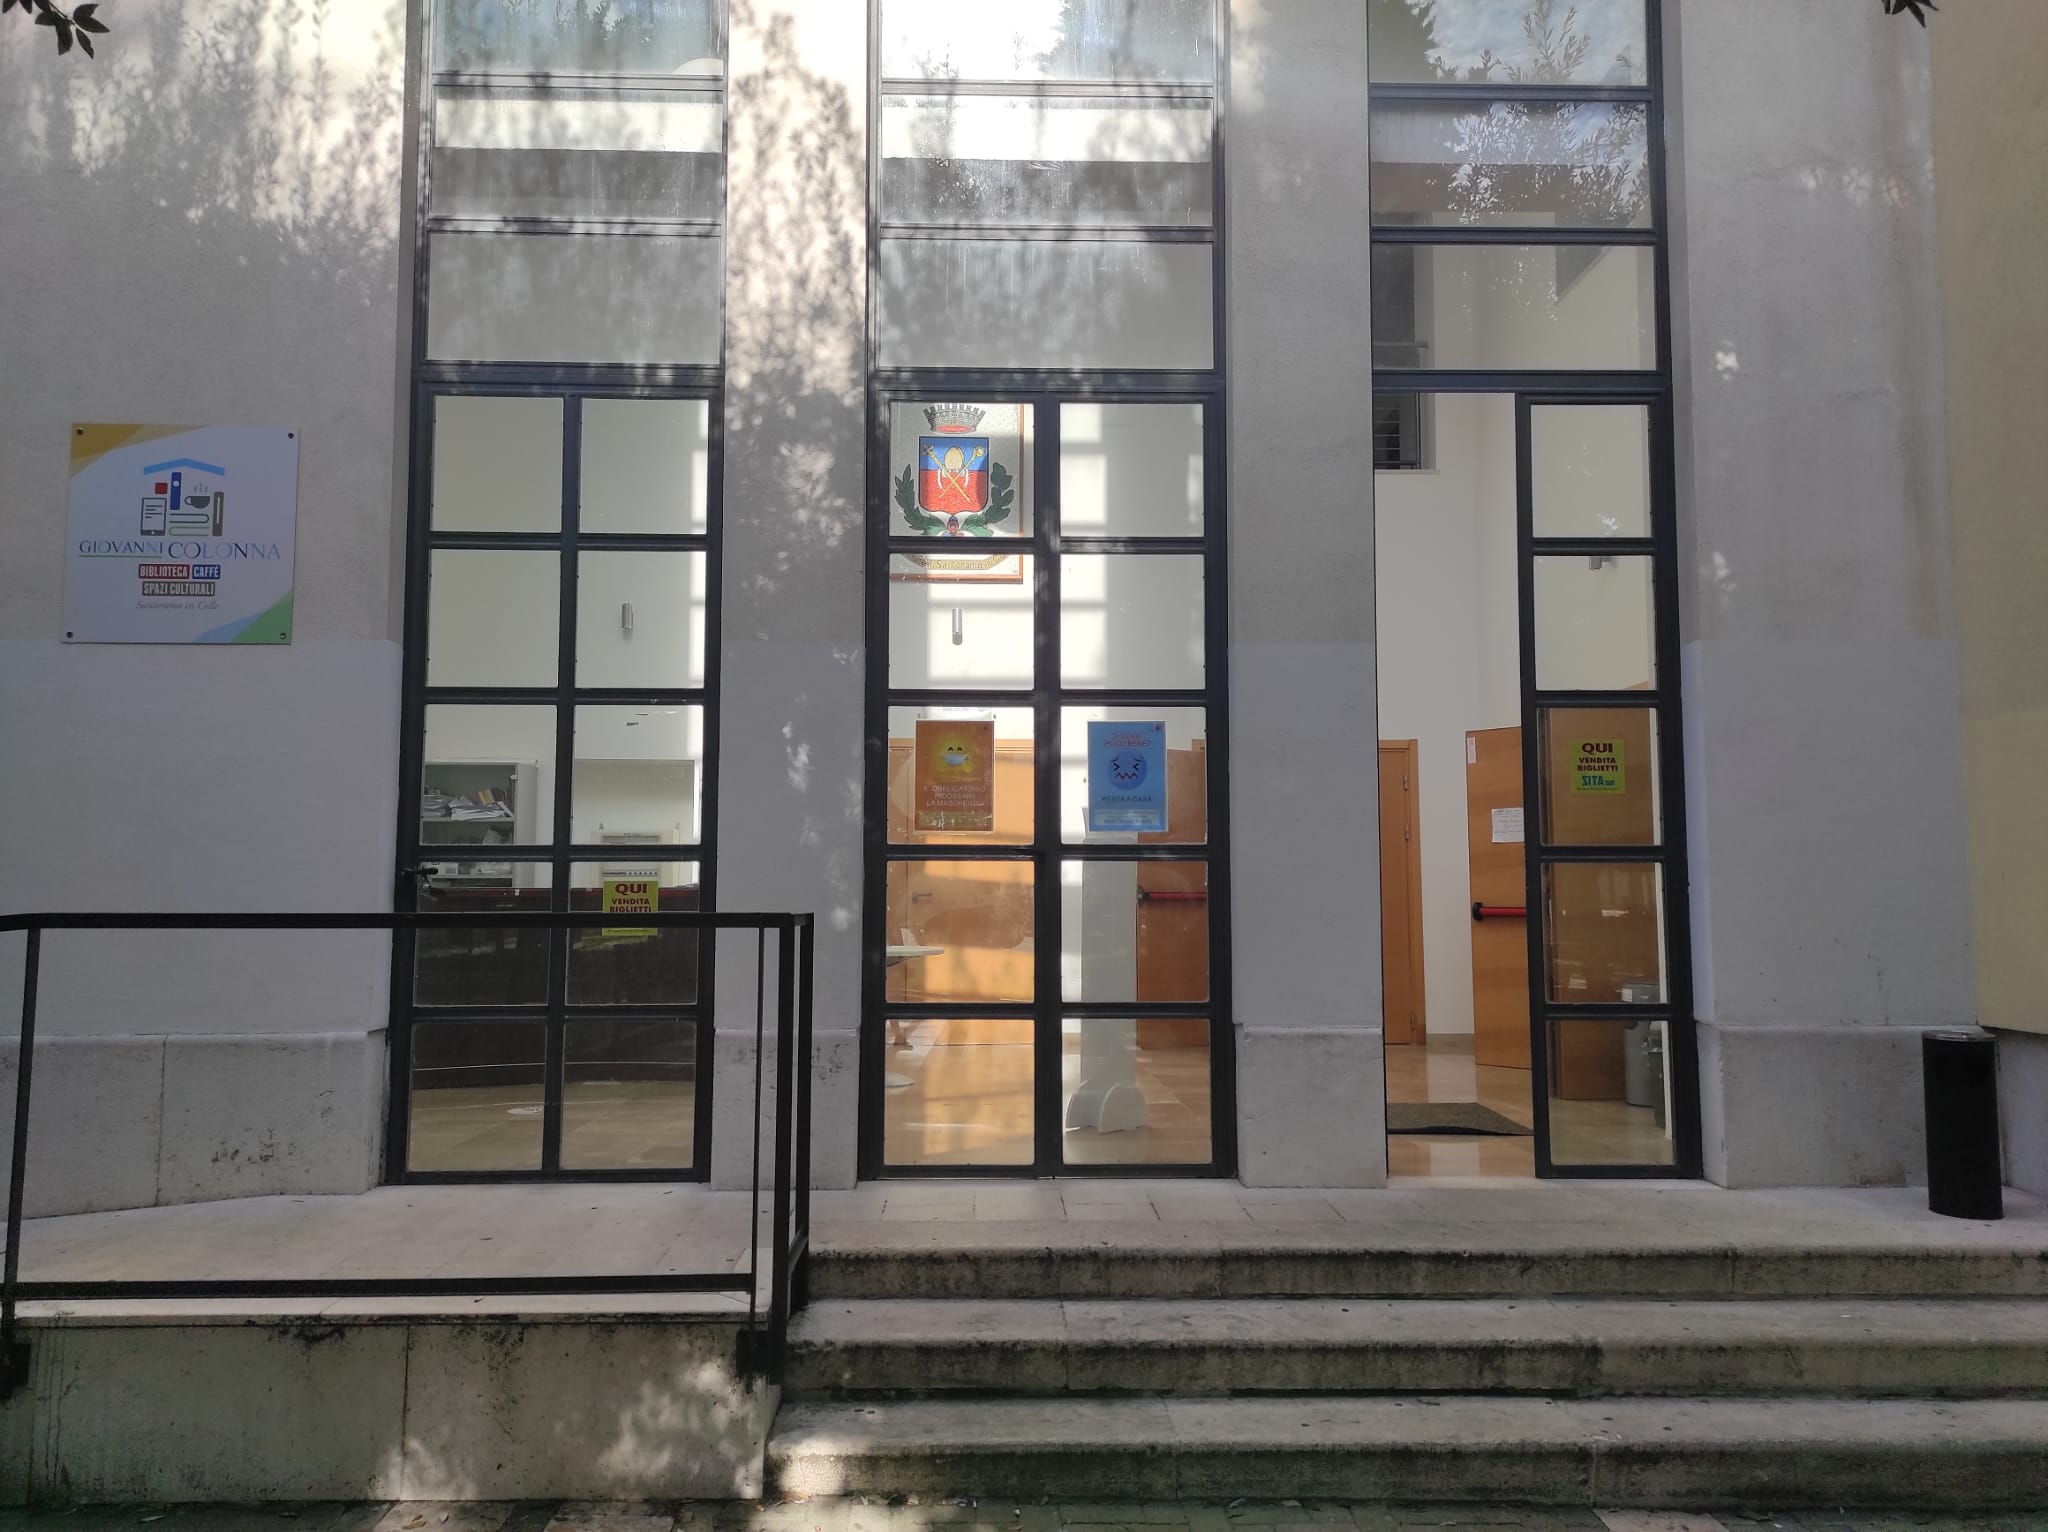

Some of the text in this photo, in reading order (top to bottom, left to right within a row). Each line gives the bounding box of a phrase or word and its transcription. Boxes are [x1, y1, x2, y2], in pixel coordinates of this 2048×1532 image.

[79, 540, 281, 560] GIOVANNI COLONNA
[140, 566, 188, 577] BIBLIOTECA
[144, 583, 214, 595] SPAZI CULTURALI
[1581, 742, 1613, 755] QUI
[1582, 775, 1604, 786] SITA
[615, 883, 648, 895] QUI
